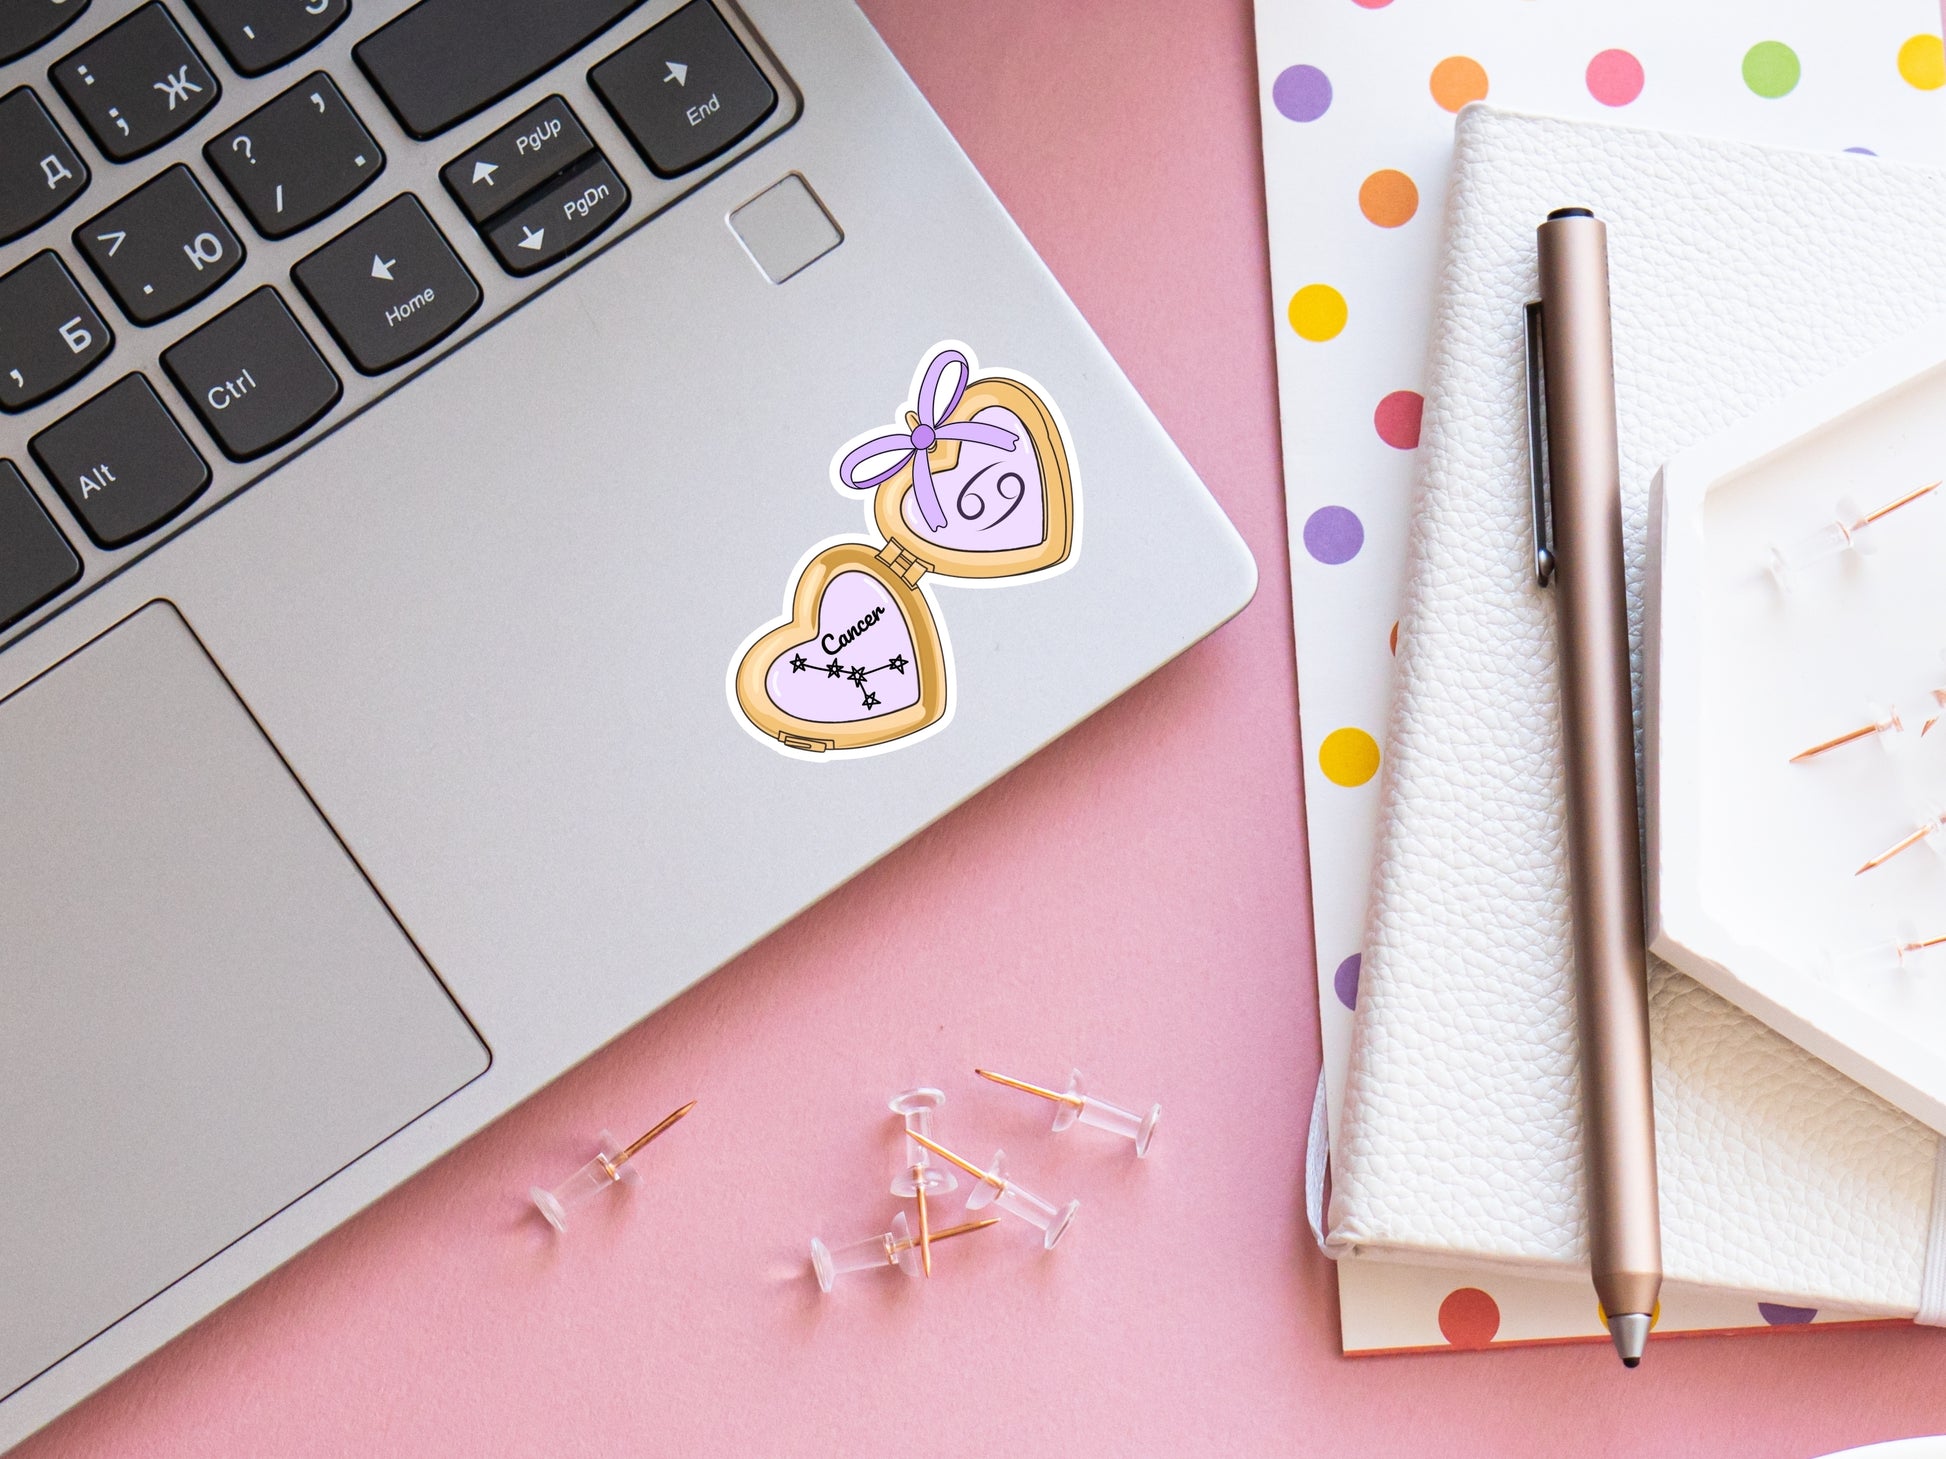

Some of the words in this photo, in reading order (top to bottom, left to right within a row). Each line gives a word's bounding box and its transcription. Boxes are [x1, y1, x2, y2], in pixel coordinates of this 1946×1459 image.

[153, 64, 203, 111] Ж
[686, 93, 721, 127] End
[515, 116, 562, 156] PgUp
[39, 154, 73, 190] Д
[563, 184, 610, 221] PgDn
[183, 232, 223, 271] Ю
[384, 287, 435, 327] Home
[58, 315, 93, 354] Б
[207, 368, 257, 410] Ctrl
[79, 464, 117, 500] Alt
[821, 606, 885, 655] Cancer
